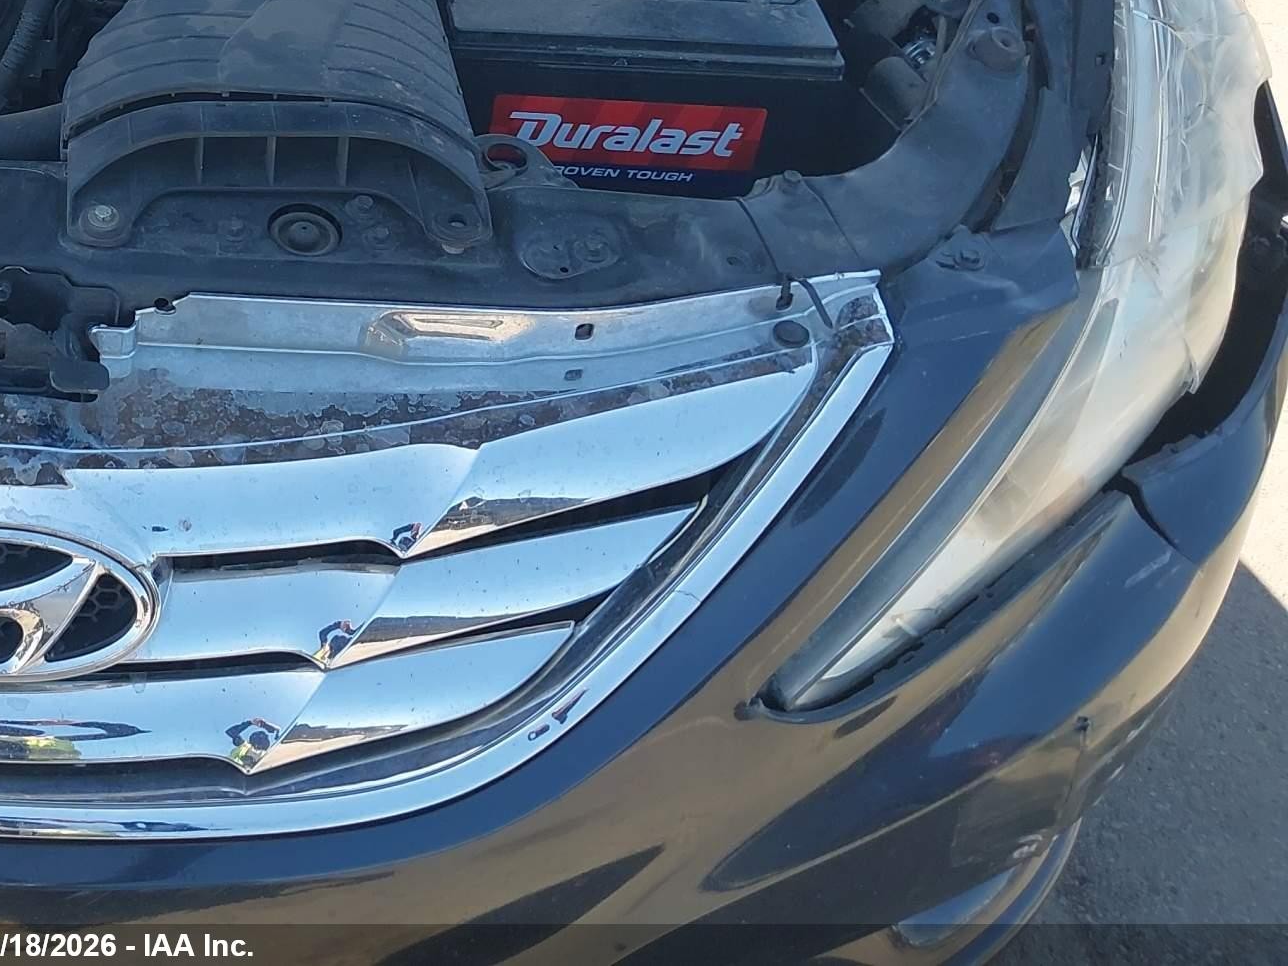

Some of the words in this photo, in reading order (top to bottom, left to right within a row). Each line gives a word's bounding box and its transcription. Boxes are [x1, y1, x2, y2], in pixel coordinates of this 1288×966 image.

[509, 111, 744, 158] Duralast
[552, 165, 620, 178] ROVEN
[627, 169, 694, 182] TOUGH
